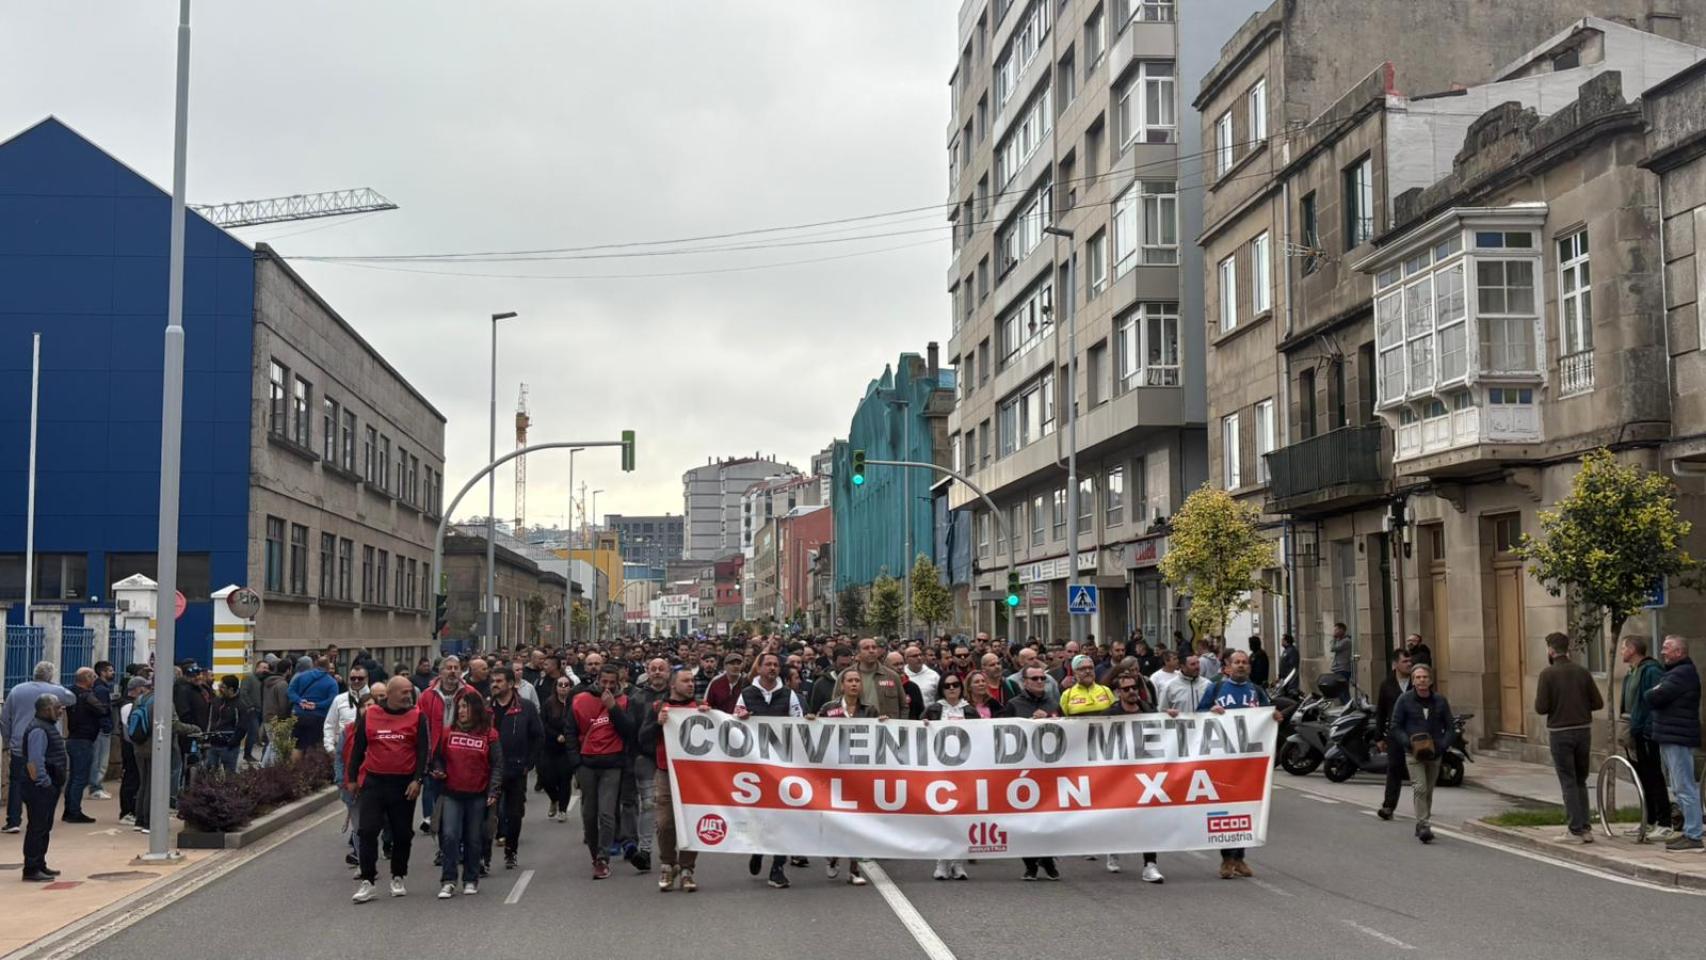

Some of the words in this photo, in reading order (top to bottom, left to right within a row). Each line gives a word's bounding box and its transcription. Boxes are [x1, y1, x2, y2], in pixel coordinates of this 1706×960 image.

[450, 736, 483, 748] CCOO
[678, 714, 971, 766] CONVENIO
[993, 724, 1067, 764] DO
[1087, 715, 1263, 761] METAL
[731, 770, 1092, 812] SOLUCIÓN
[1136, 770, 1220, 804] XA
[700, 818, 724, 832] UGT
[1210, 817, 1249, 830] CCOO
[968, 822, 1007, 845] CIG
[1208, 832, 1253, 843] industria
